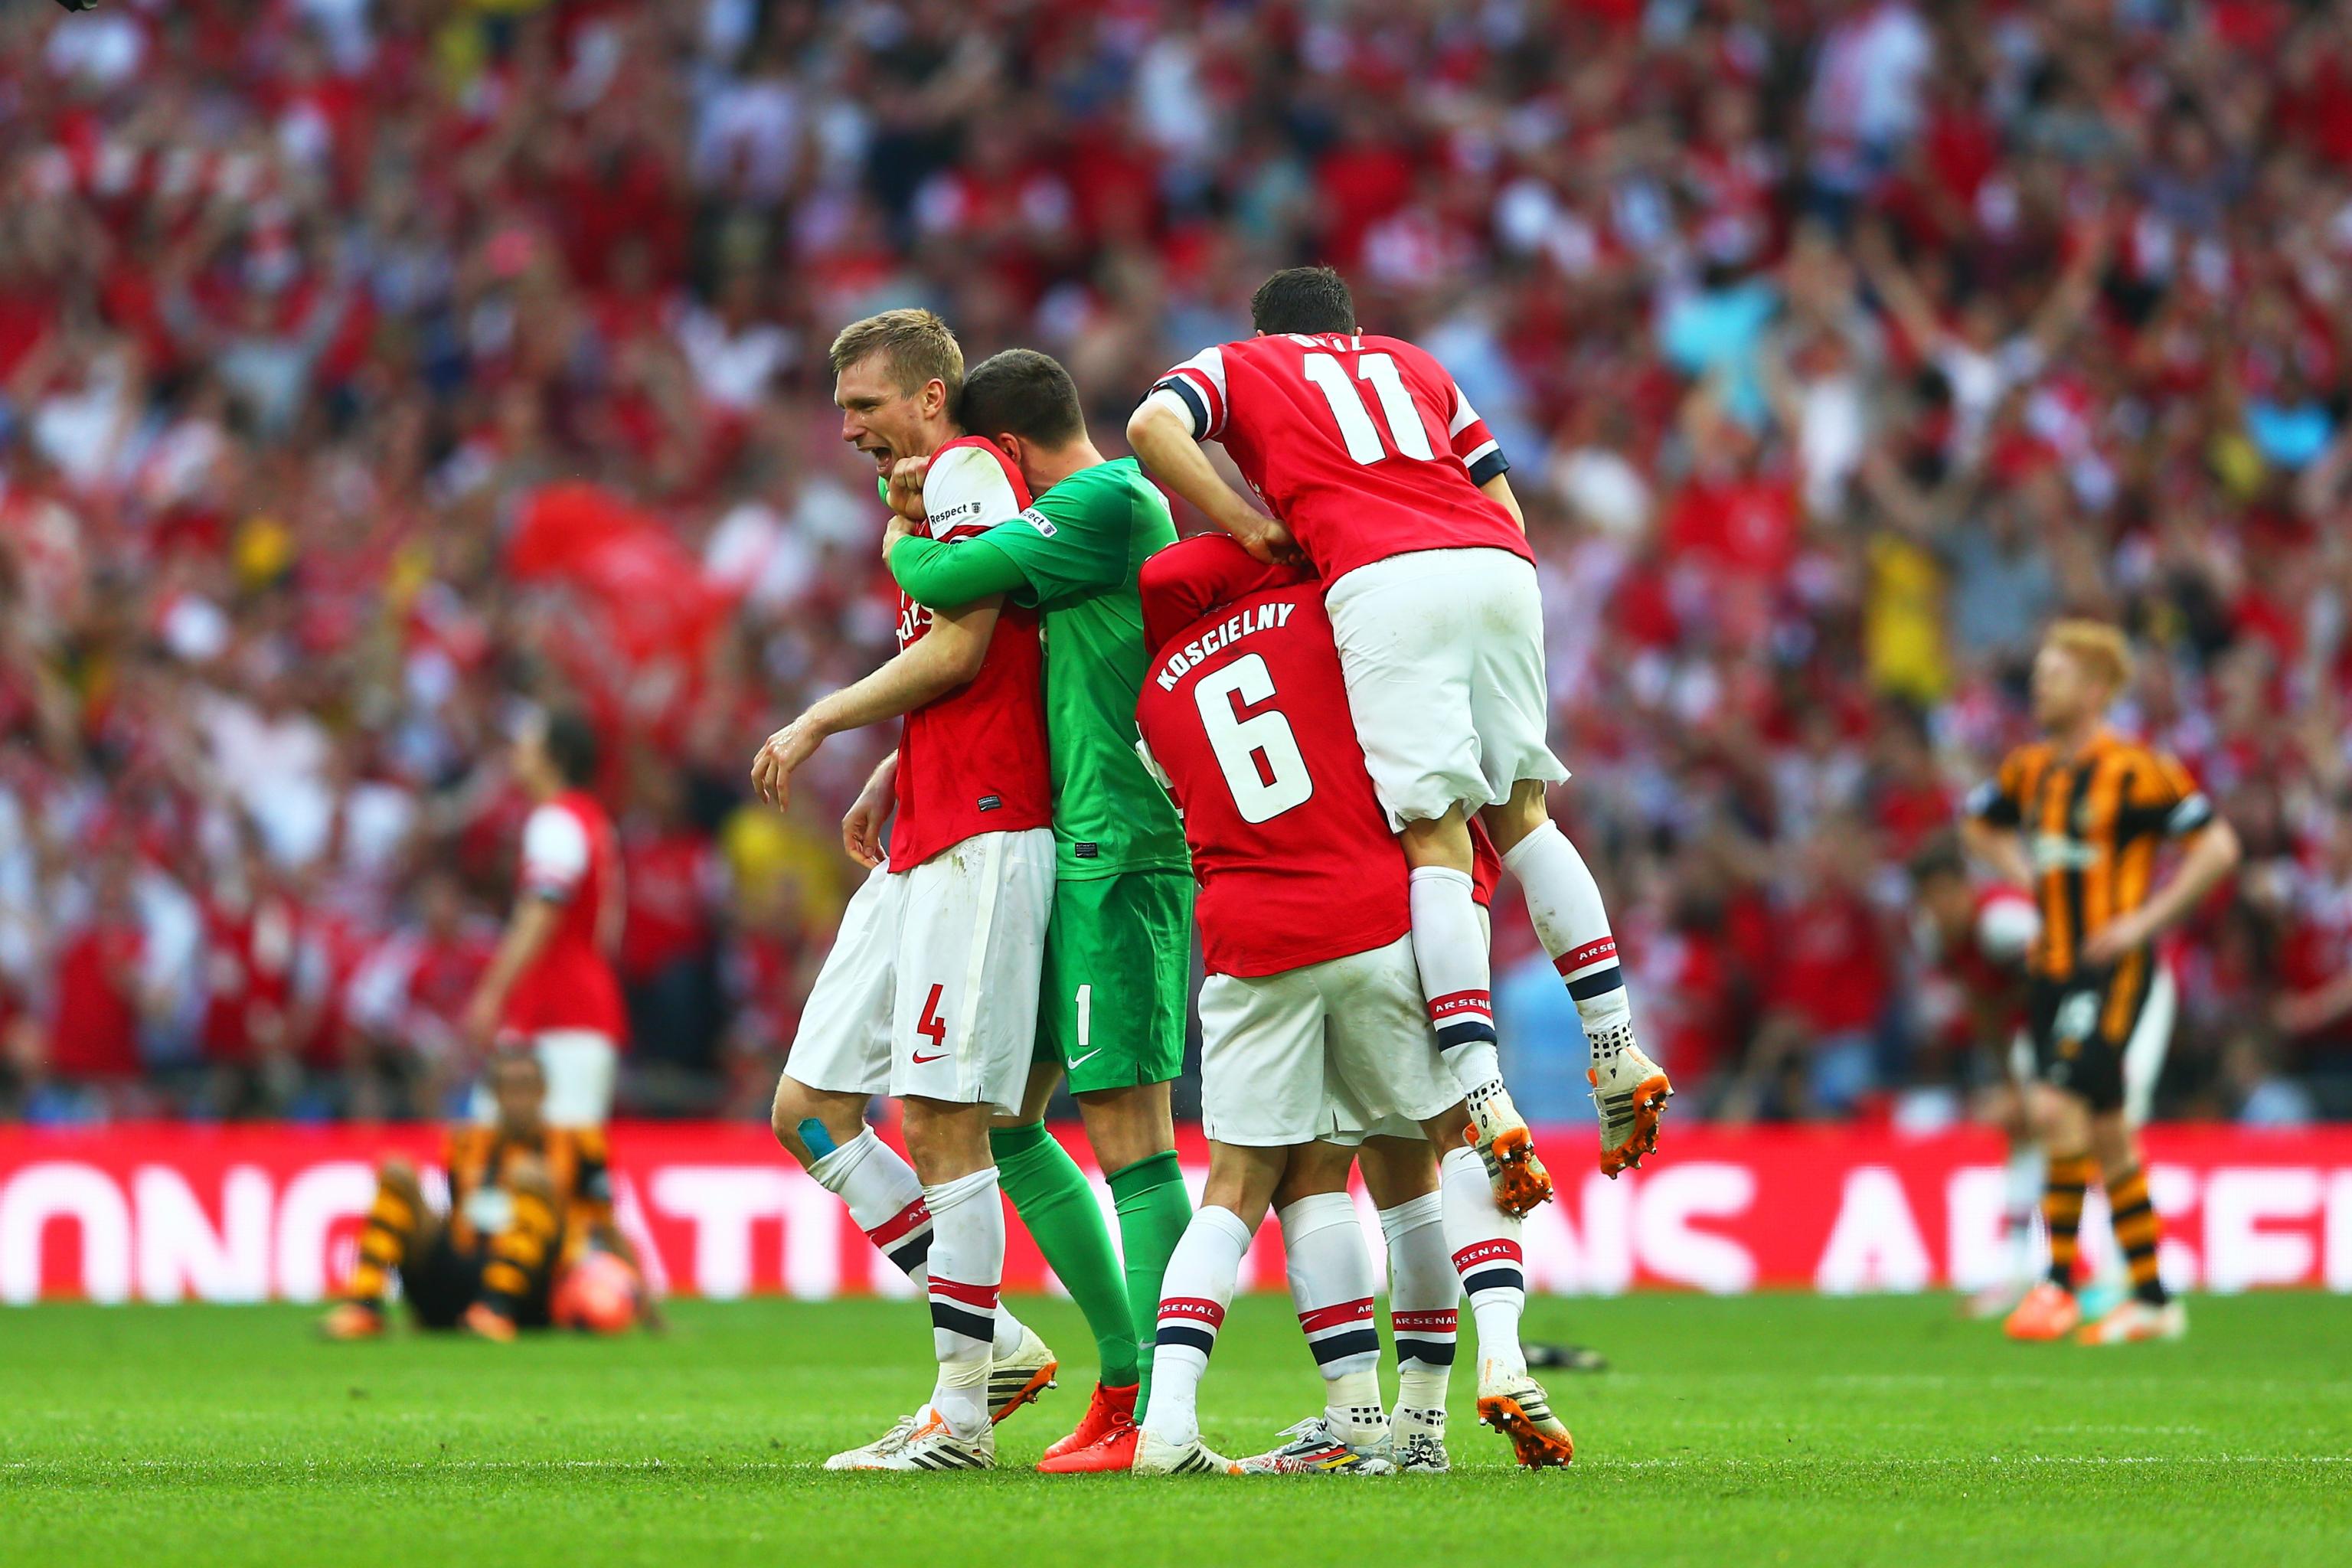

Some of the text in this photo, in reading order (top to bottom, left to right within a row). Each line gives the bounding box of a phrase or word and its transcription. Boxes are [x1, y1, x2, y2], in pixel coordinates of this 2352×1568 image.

[1303, 352, 1436, 466] 11
[929, 503, 967, 525] Respect
[1020, 511, 1044, 526] pect
[1155, 603, 1295, 692] KOSCIELNY
[1193, 652, 1314, 824] 6
[916, 983, 946, 1047] 4
[1074, 983, 1093, 1047] 1
[1395, 1316, 1457, 1325] ARSENAL
